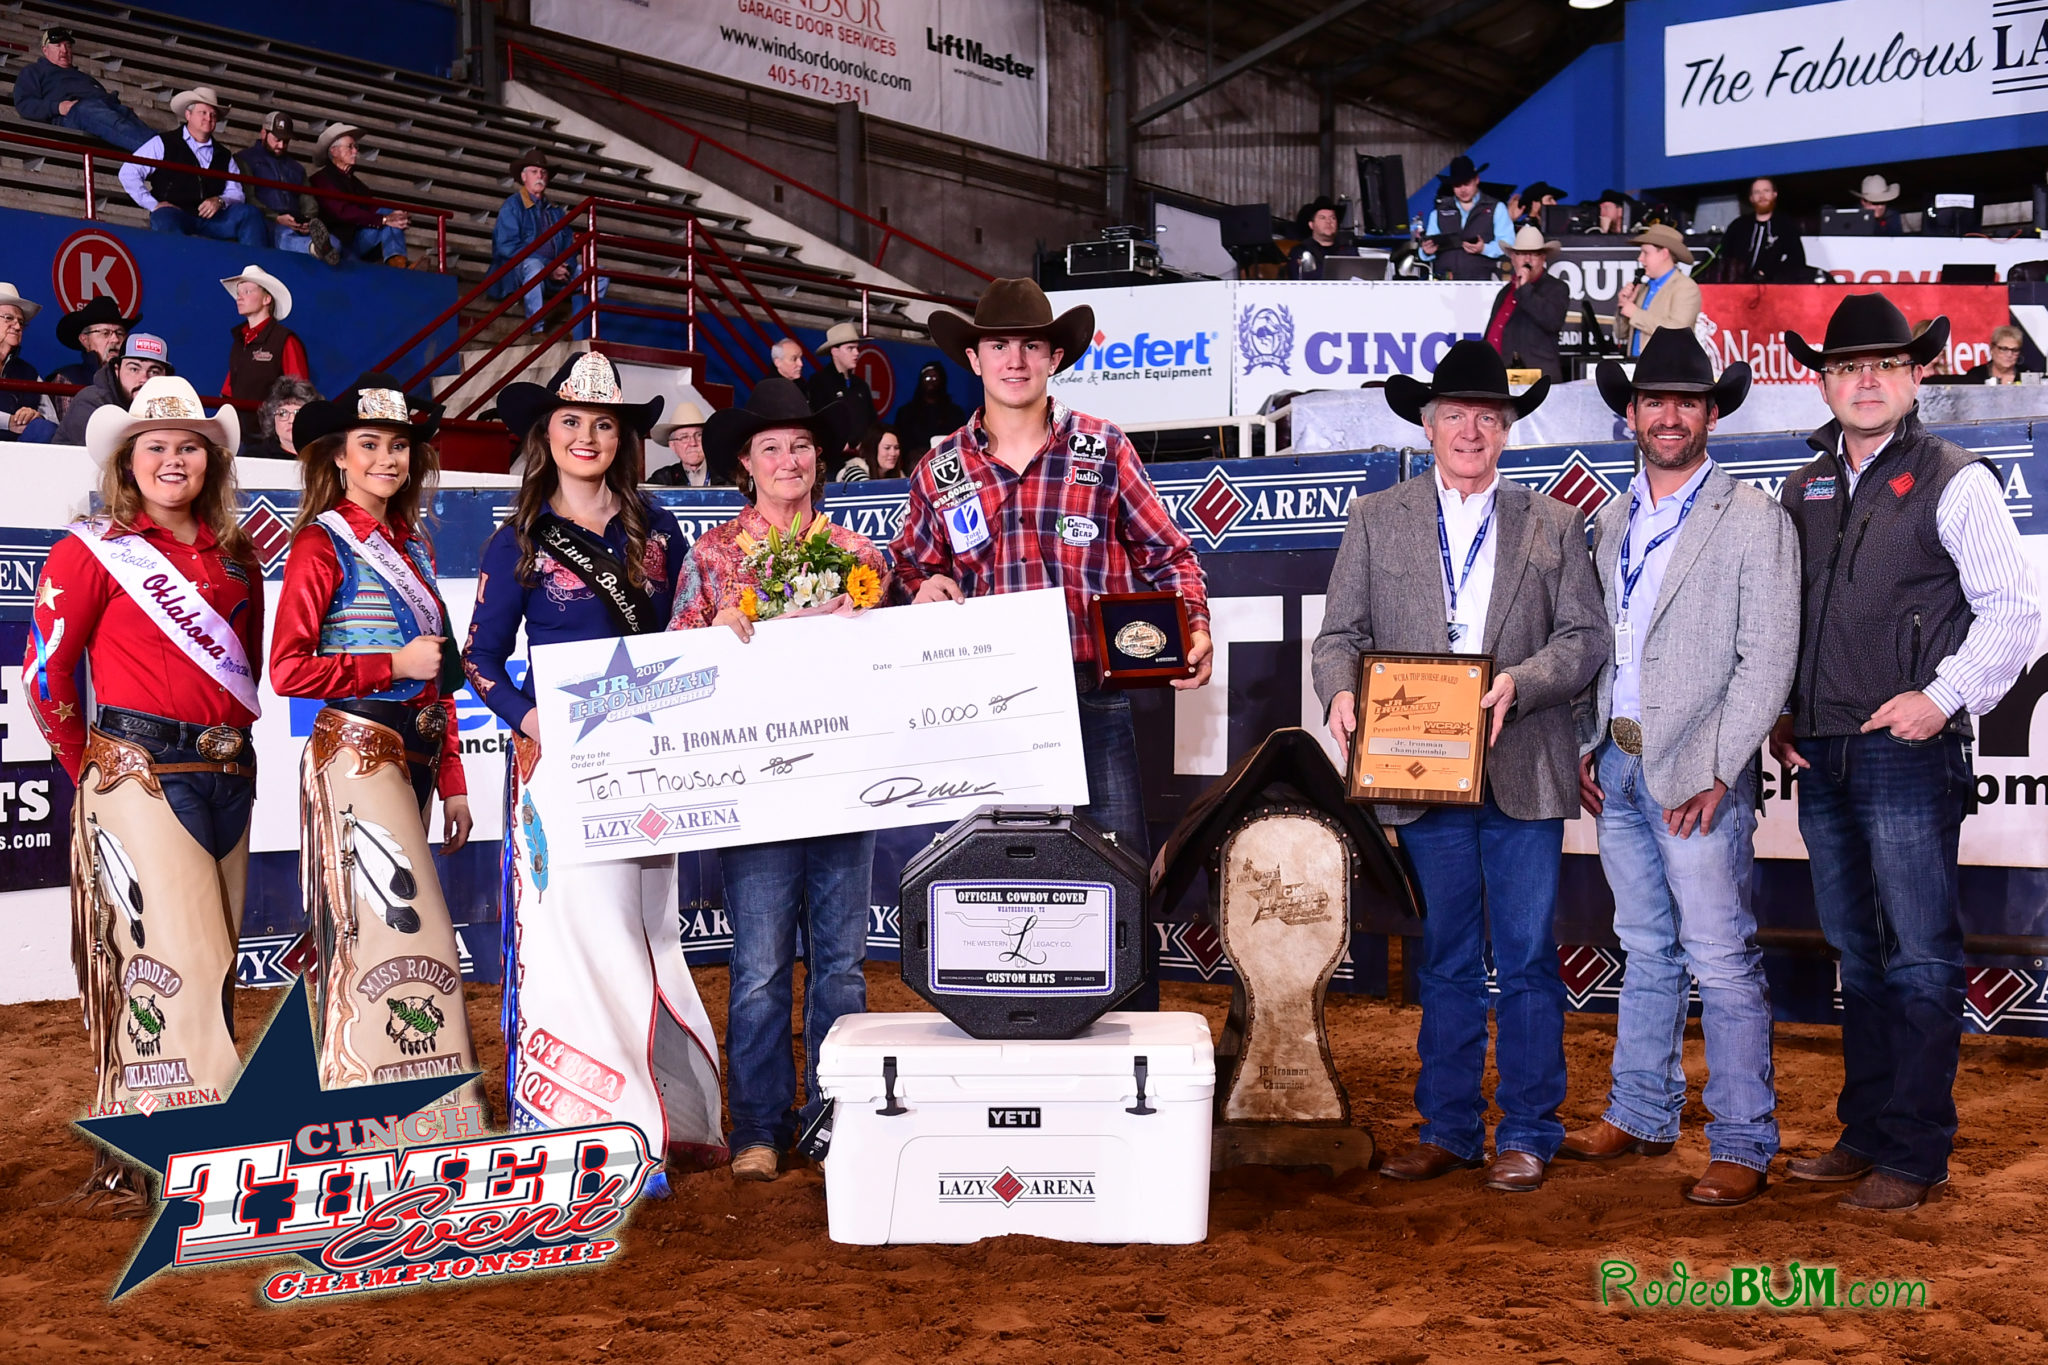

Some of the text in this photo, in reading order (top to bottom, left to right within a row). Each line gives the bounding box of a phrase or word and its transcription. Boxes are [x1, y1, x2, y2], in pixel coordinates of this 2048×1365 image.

[738, 0, 897, 56] GARAGE DOOR SERVICES
[719, 25, 912, 92] www.windsordoorokc.com
[1681, 53, 1754, 108] The
[1766, 31, 1984, 98] Fabulous
[768, 64, 870, 106] 405-672-3351
[80, 252, 119, 305] K
[1073, 329, 1211, 371] riefert
[1102, 370, 1140, 381] Ranch
[1145, 367, 1212, 381] Equipment
[1064, 466, 1100, 485] Justin
[939, 482, 976, 506] BLOOMER
[111, 549, 157, 570] Rodeo
[373, 553, 406, 578] Rodeo
[396, 578, 436, 625] Oklahoma
[549, 536, 641, 633] Little Britches
[143, 573, 226, 660] Oklahoma
[872, 662, 893, 671] Date
[973, 644, 992, 655] 2019
[589, 674, 637, 698] JR.
[636, 662, 665, 679] 2019
[571, 668, 716, 721] IRONMAN
[1375, 702, 1440, 714] IRONMAN
[1373, 725, 1411, 734] Presented
[1412, 725, 1421, 733] by
[1424, 721, 1461, 729] WCRA
[1032, 741, 1061, 750] Dollars
[1390, 748, 1447, 756] Championship
[1408, 740, 1443, 748] Ironman
[577, 772, 623, 800] Ten
[627, 764, 747, 794] Thousand
[583, 819, 632, 840] LAZY
[674, 807, 740, 830] ARENA
[958, 891, 1085, 904] OFFICIAL COWBOY COVER
[1033, 940, 1059, 948] LEGACY
[137, 958, 180, 994] RODEO
[360, 958, 457, 998] MISS RODEO
[986, 972, 1027, 984] CUSTOM
[1029, 973, 1056, 984] HATS
[125, 1061, 189, 1089] OKLAHOMA
[990, 1110, 1037, 1125] YETI
[939, 1179, 988, 1196] LAZY
[1029, 1179, 1096, 1195] ARENA
